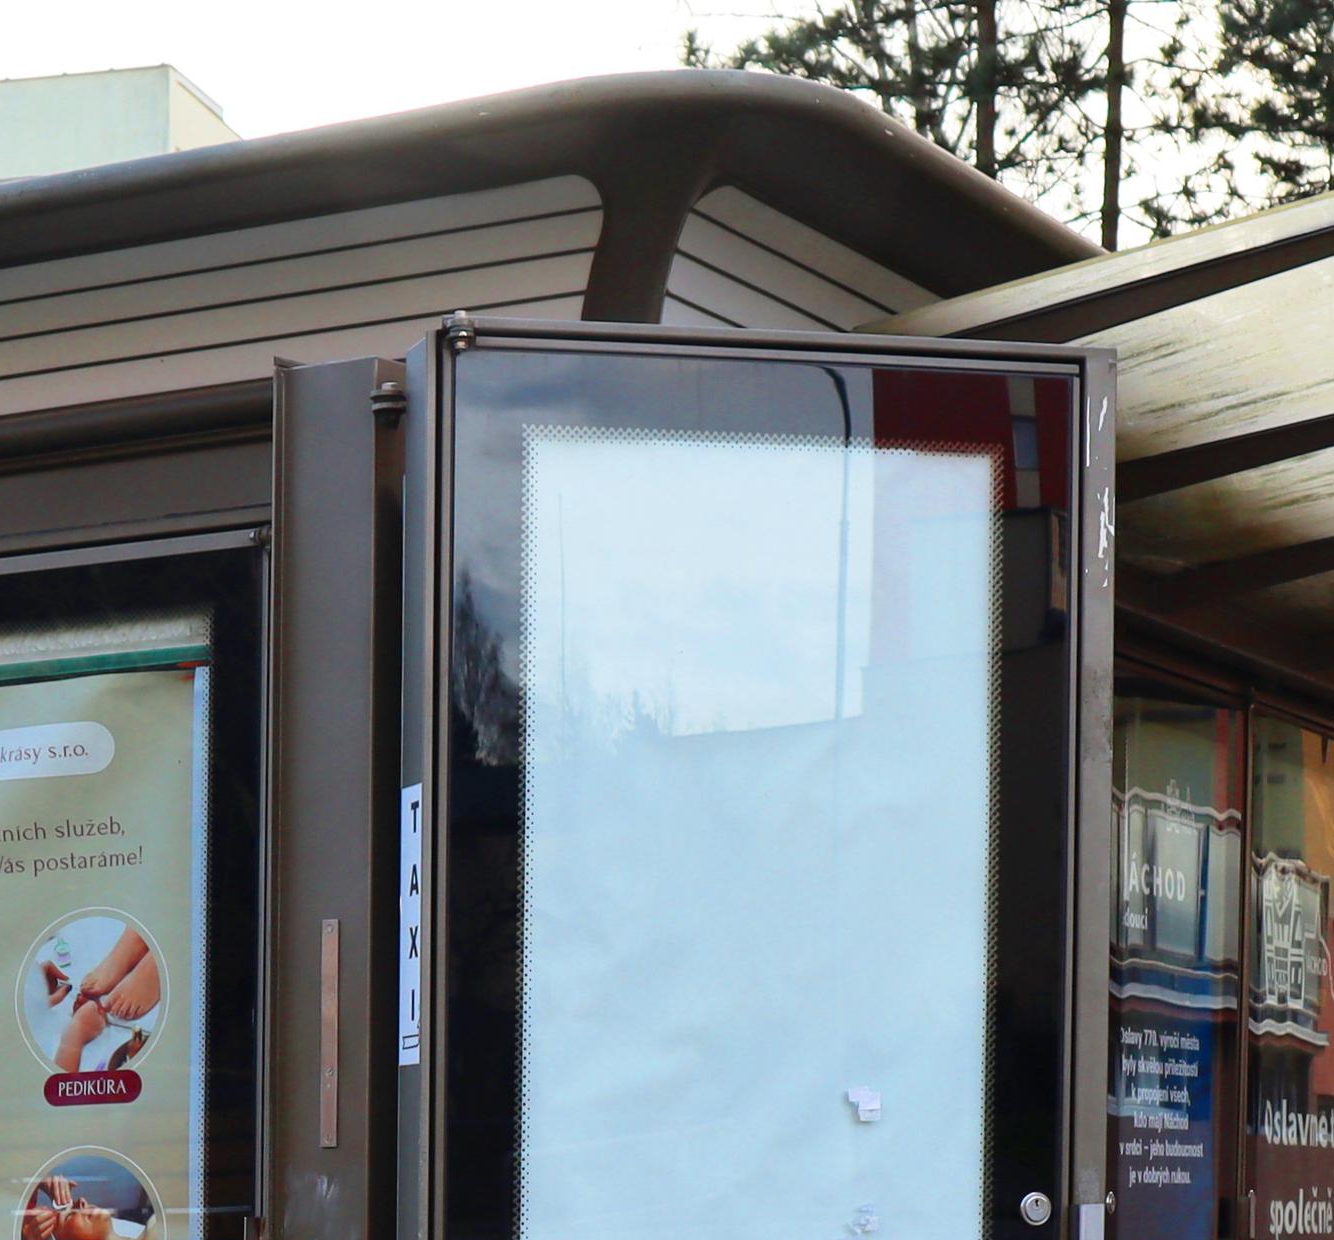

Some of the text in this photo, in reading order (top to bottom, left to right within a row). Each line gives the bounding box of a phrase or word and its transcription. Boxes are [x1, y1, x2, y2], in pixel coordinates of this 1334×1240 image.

[0, 745, 42, 765] krásy
[48, 743, 89, 759] s.r.o.
[54, 815, 126, 839] služeb,
[33, 845, 144, 877] postaráme!
[408, 800, 420, 1022] TAXI
